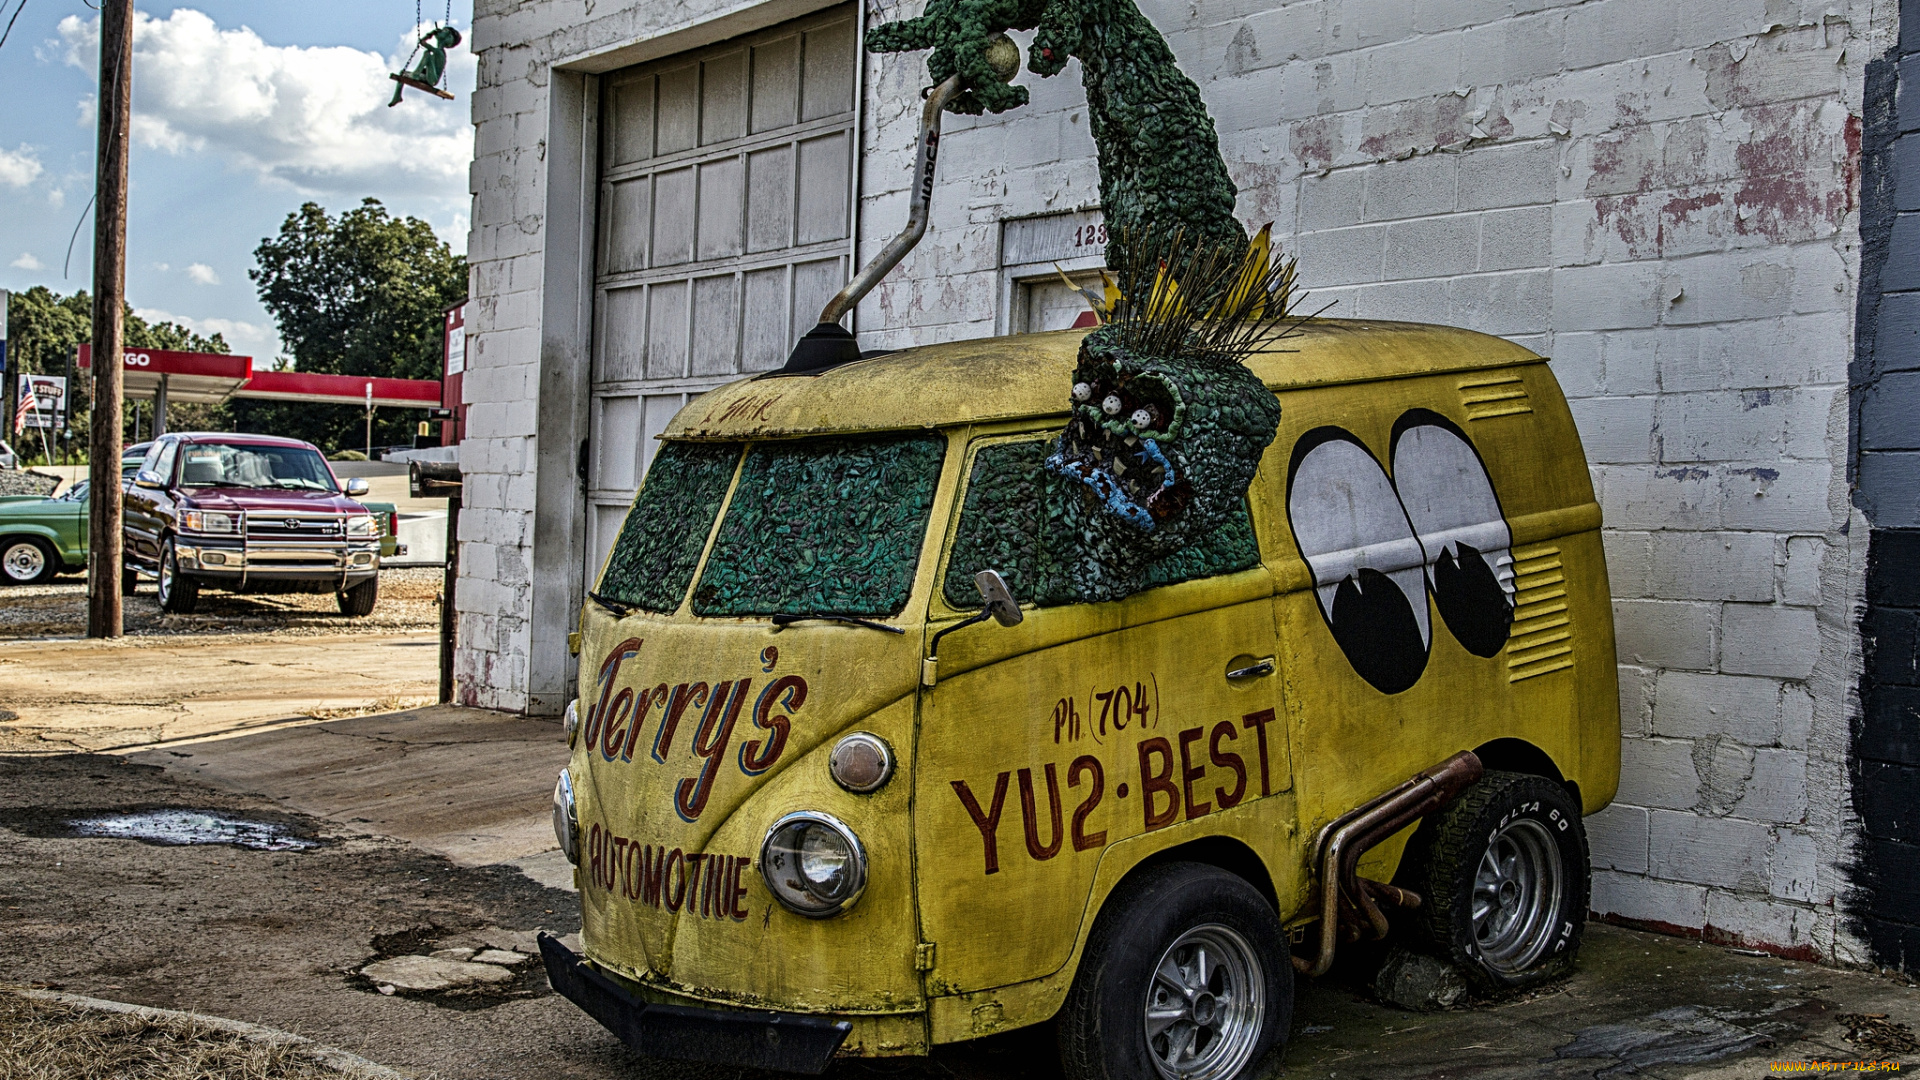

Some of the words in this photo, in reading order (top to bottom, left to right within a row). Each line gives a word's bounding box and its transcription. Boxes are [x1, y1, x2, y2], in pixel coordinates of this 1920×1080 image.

[921, 130, 940, 211] HURST
[584, 637, 809, 824] Jerry's
[1049, 695, 1081, 744] Ph
[1088, 672, 1160, 745] (704)
[1488, 801, 1540, 844] DELTA
[1549, 808, 1569, 832] 60
